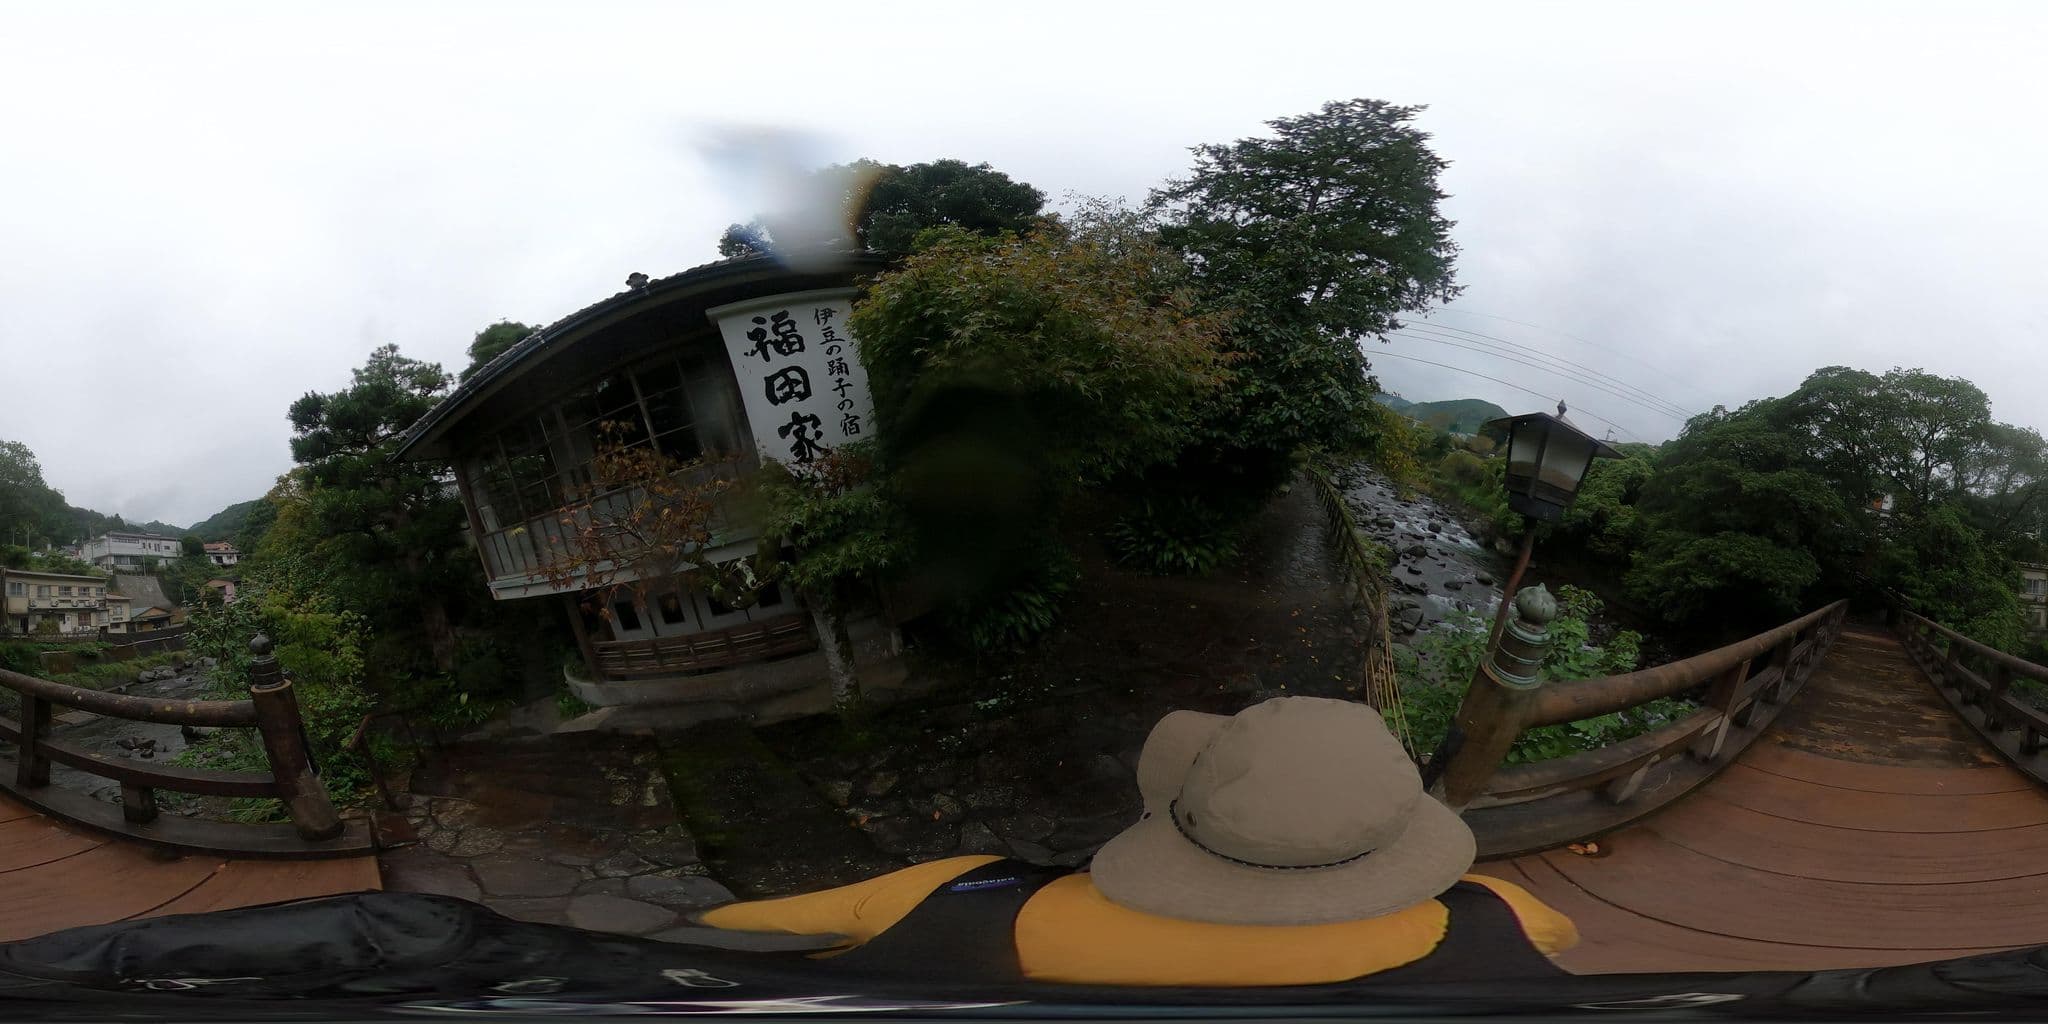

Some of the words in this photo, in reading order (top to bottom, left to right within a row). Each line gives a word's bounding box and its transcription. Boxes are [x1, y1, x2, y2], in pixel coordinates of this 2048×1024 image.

[743, 309, 825, 464] 福田家
[813, 307, 861, 437] 伊豆の踊子の宿
